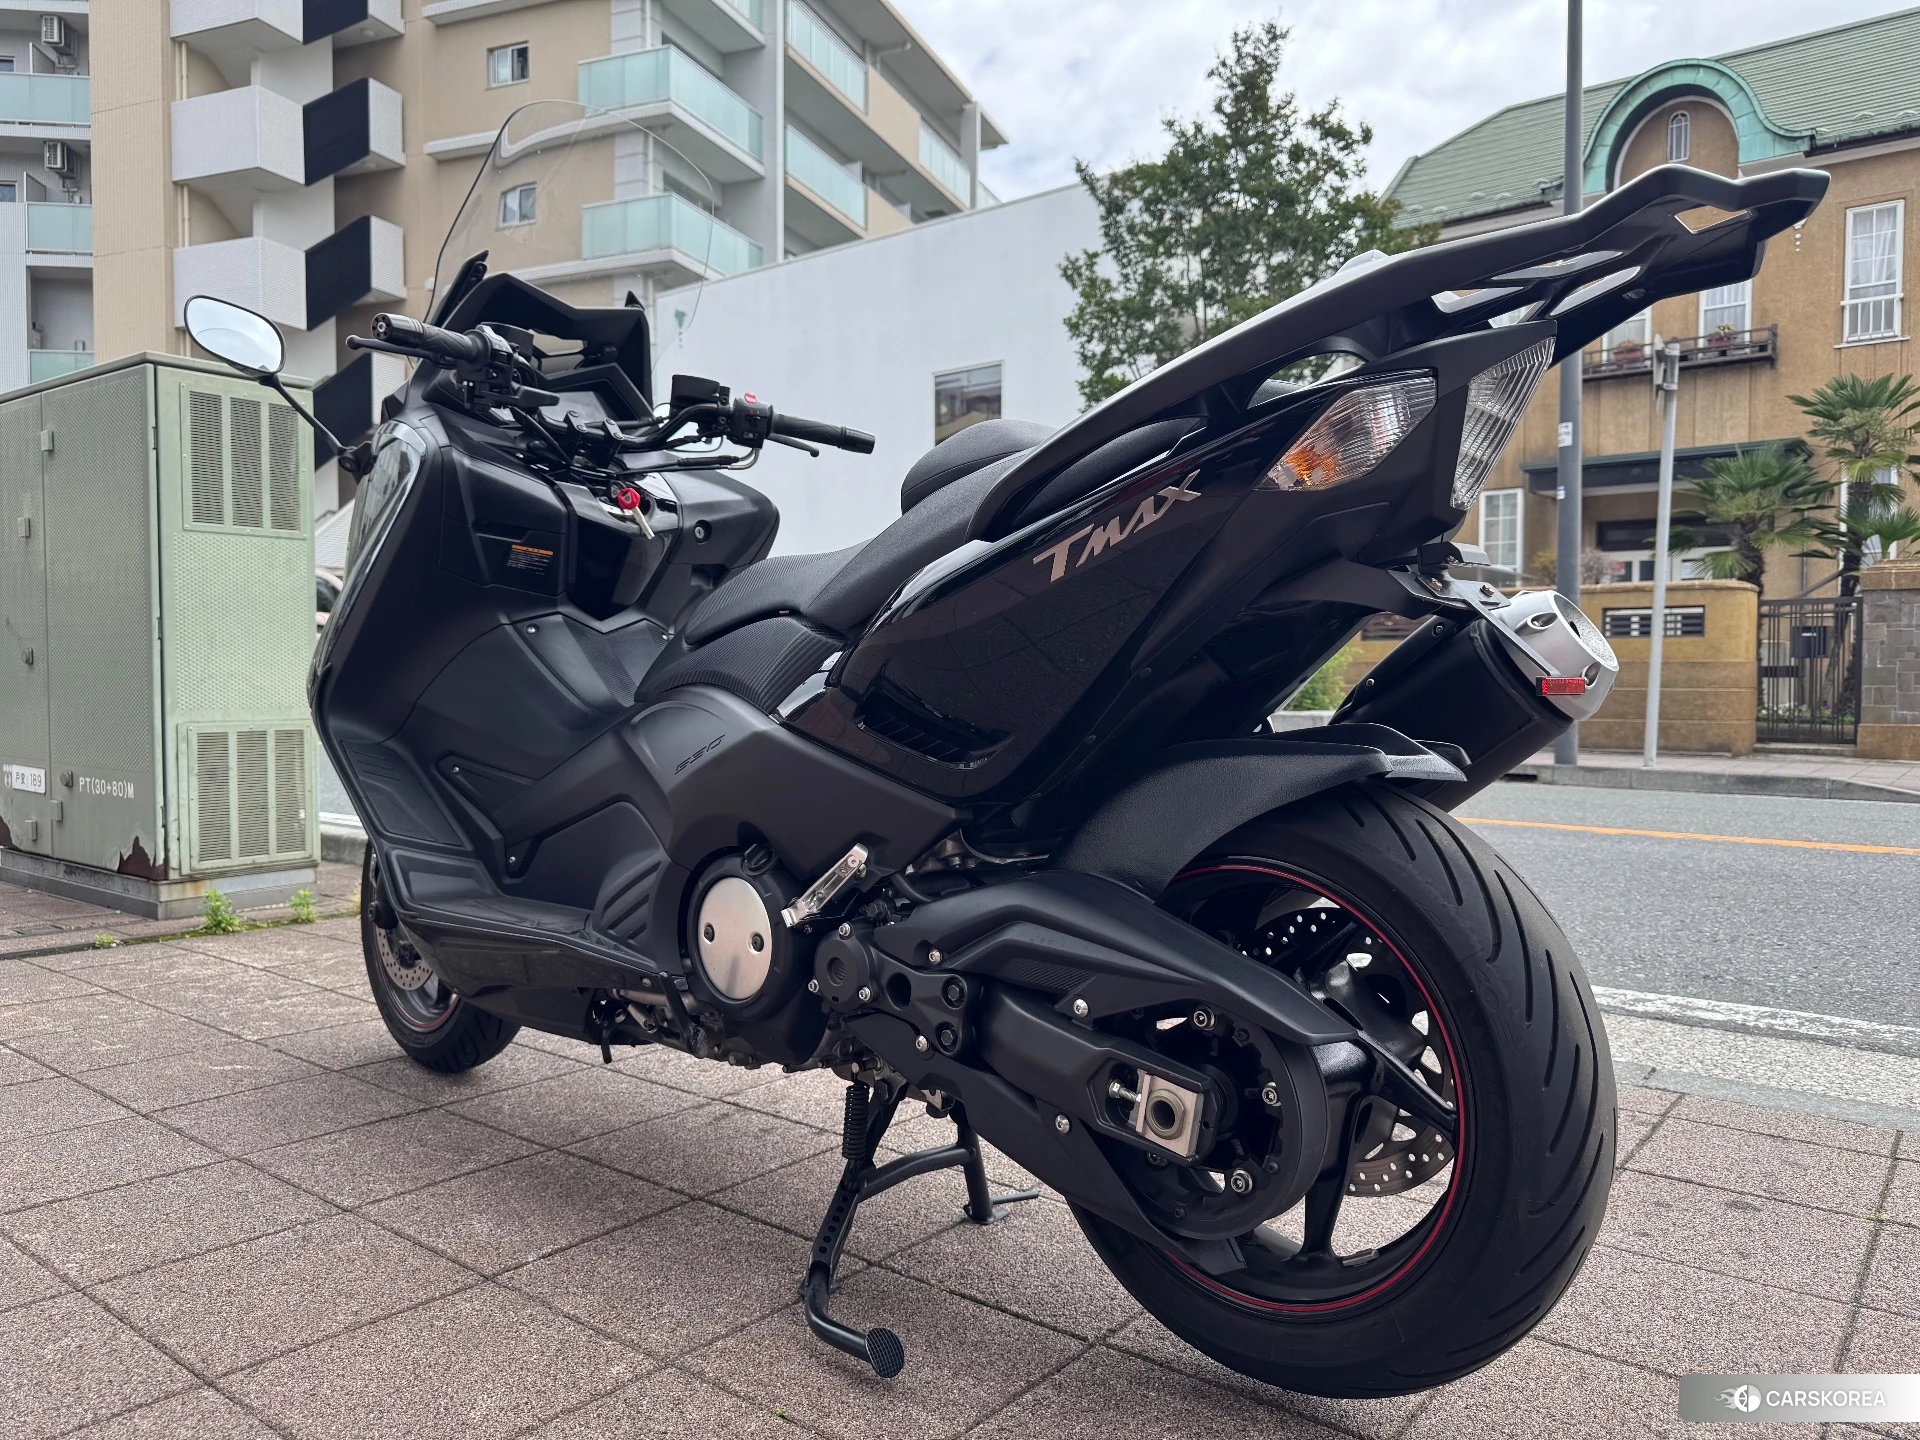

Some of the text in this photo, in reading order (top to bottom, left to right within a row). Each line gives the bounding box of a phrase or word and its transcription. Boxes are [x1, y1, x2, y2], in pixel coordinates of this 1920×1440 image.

[1032, 468, 1202, 582] TMAX
[29, 773, 42, 788] 189
[79, 776, 135, 799] PT(30+80)M
